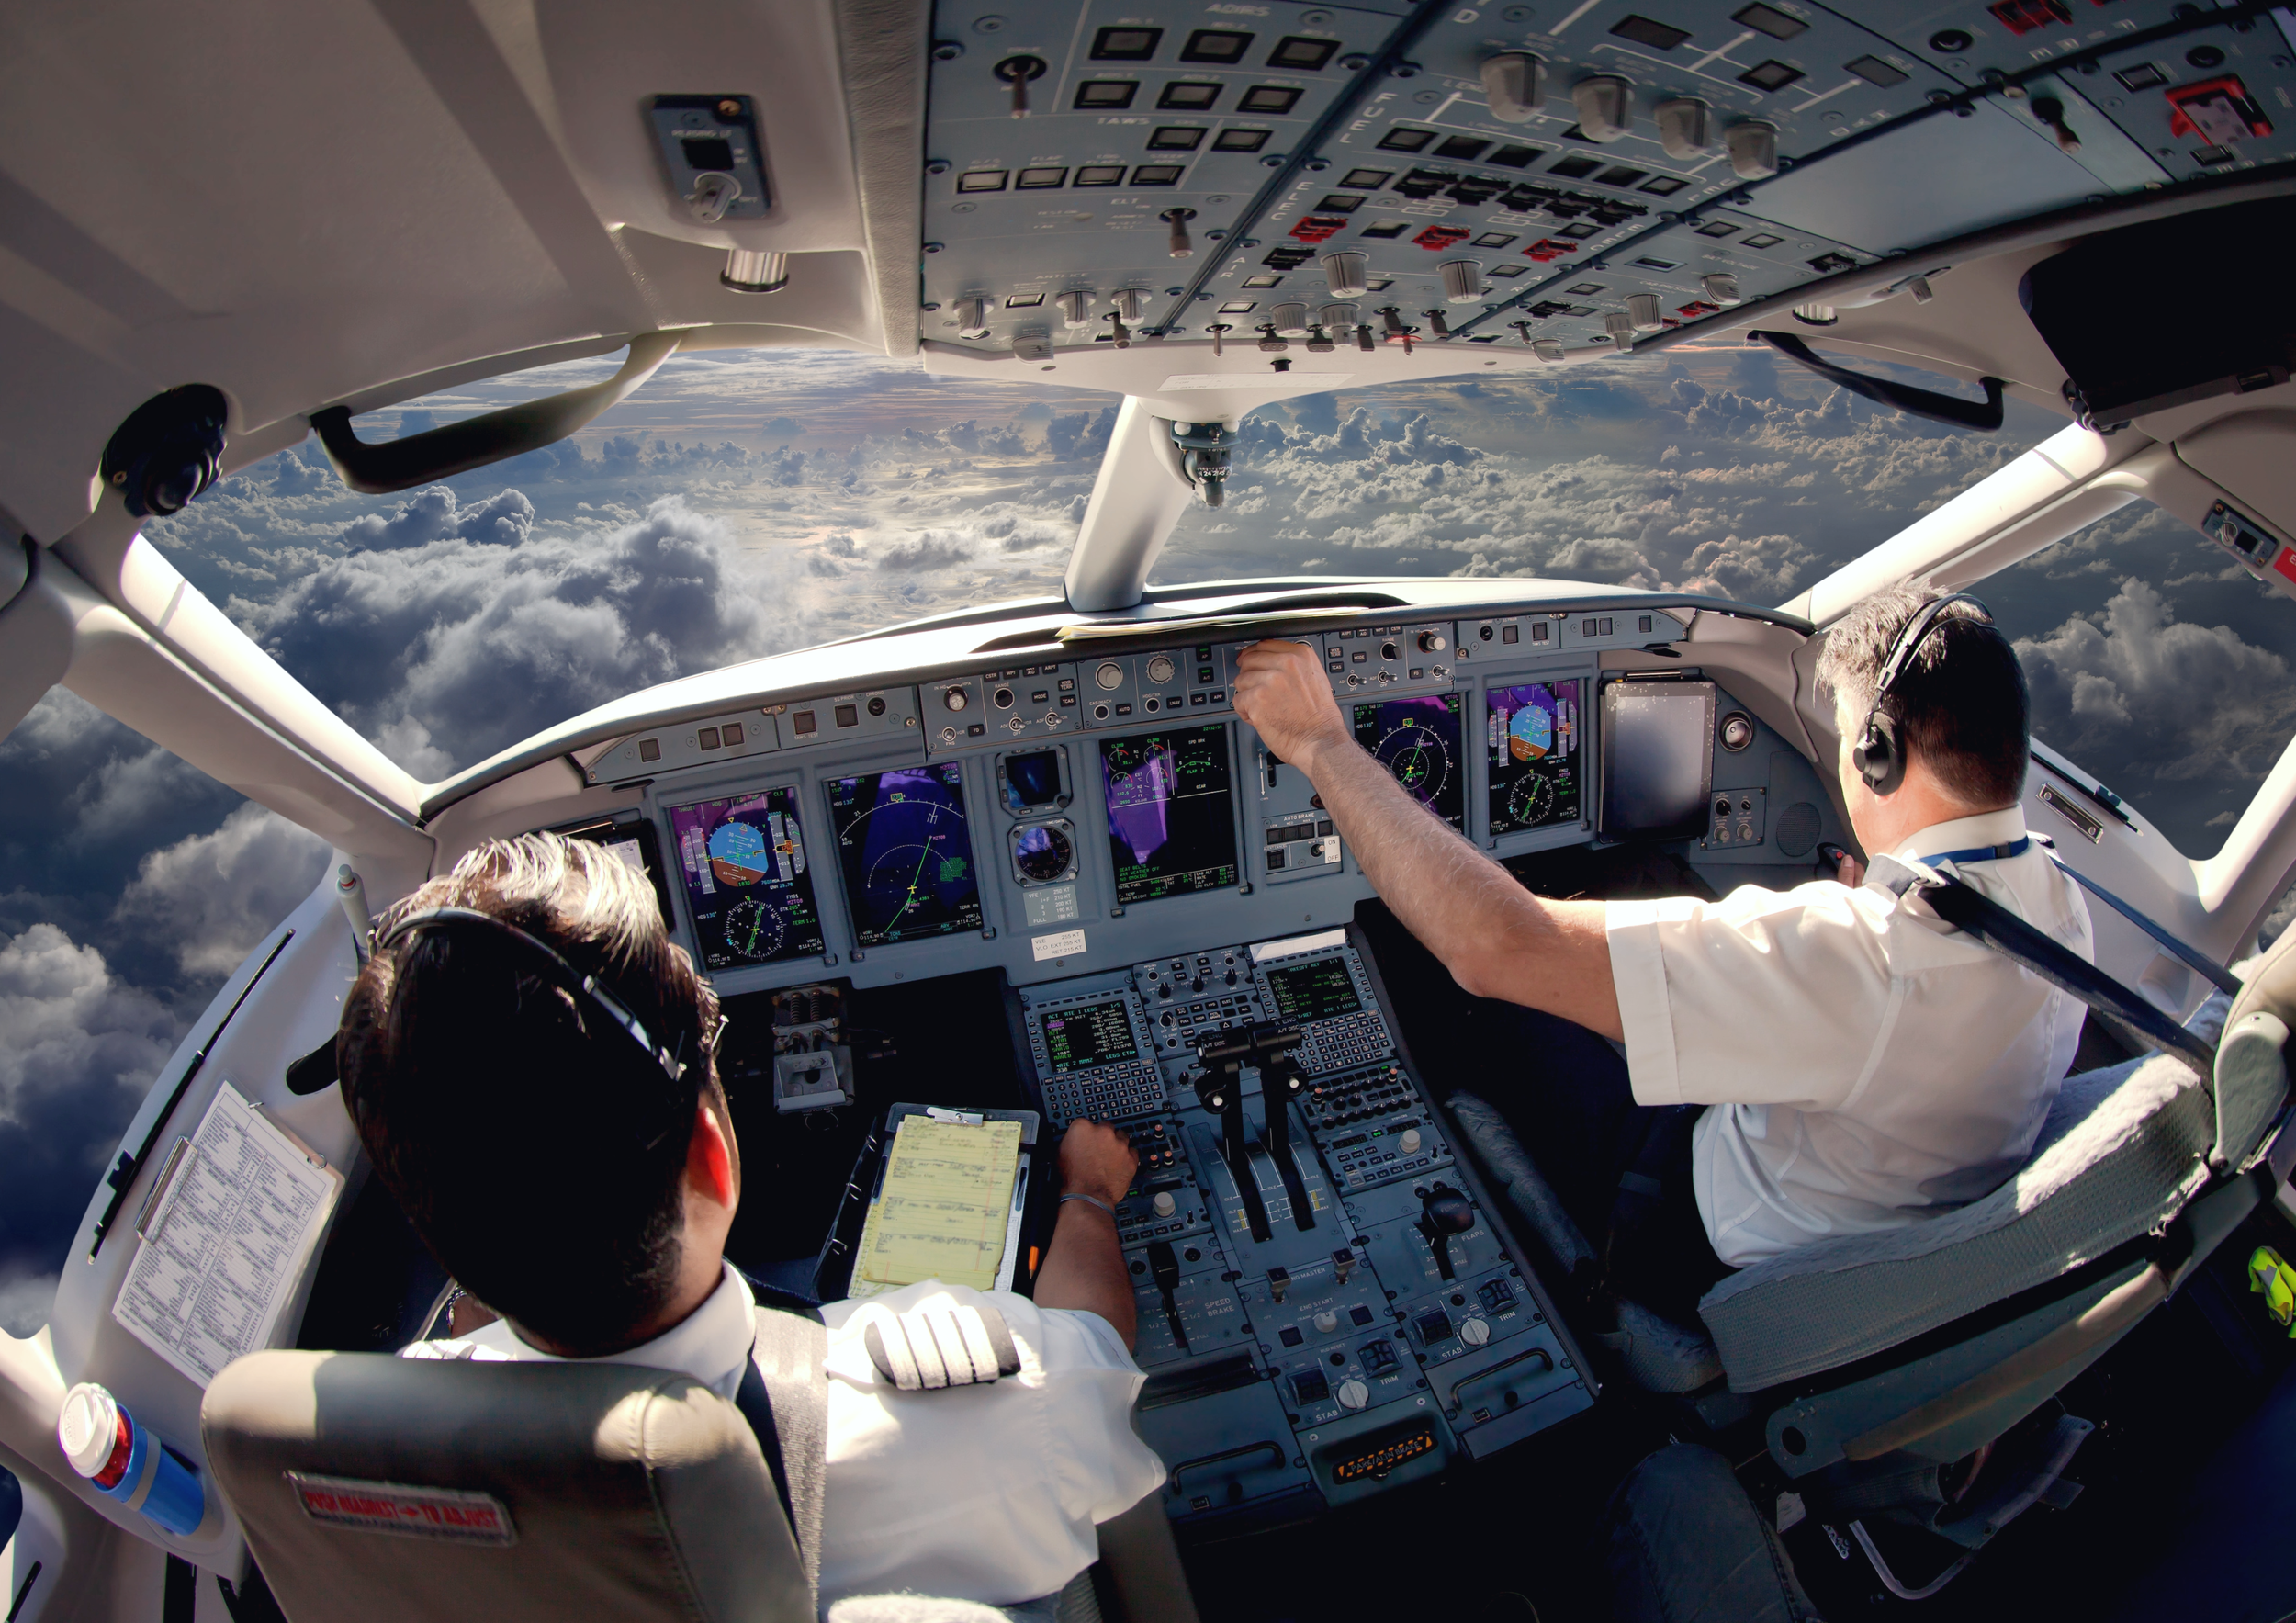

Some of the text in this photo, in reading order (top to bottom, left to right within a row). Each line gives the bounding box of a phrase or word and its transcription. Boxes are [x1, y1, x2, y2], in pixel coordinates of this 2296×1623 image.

[1097, 117, 1152, 126] TAWS
[1441, 1202, 1460, 1213] FLAPS
[1461, 1229, 1485, 1242] FLAPS
[1304, 1268, 1326, 1279] MASTER
[1451, 1284, 1464, 1293] RESET
[1204, 1297, 1231, 1310] SPEED
[1299, 1297, 1334, 1312] ENG START
[1207, 1304, 1234, 1317] BRAKE
[1498, 1311, 1516, 1322] TRIM
[1441, 1347, 1463, 1359] STAB
[1379, 1375, 1399, 1386] TRIM
[1315, 1410, 1339, 1422] STAB
[1351, 1441, 1421, 1472] PARK/ALTN BRAKE
[418, 1504, 442, 1525] TO
